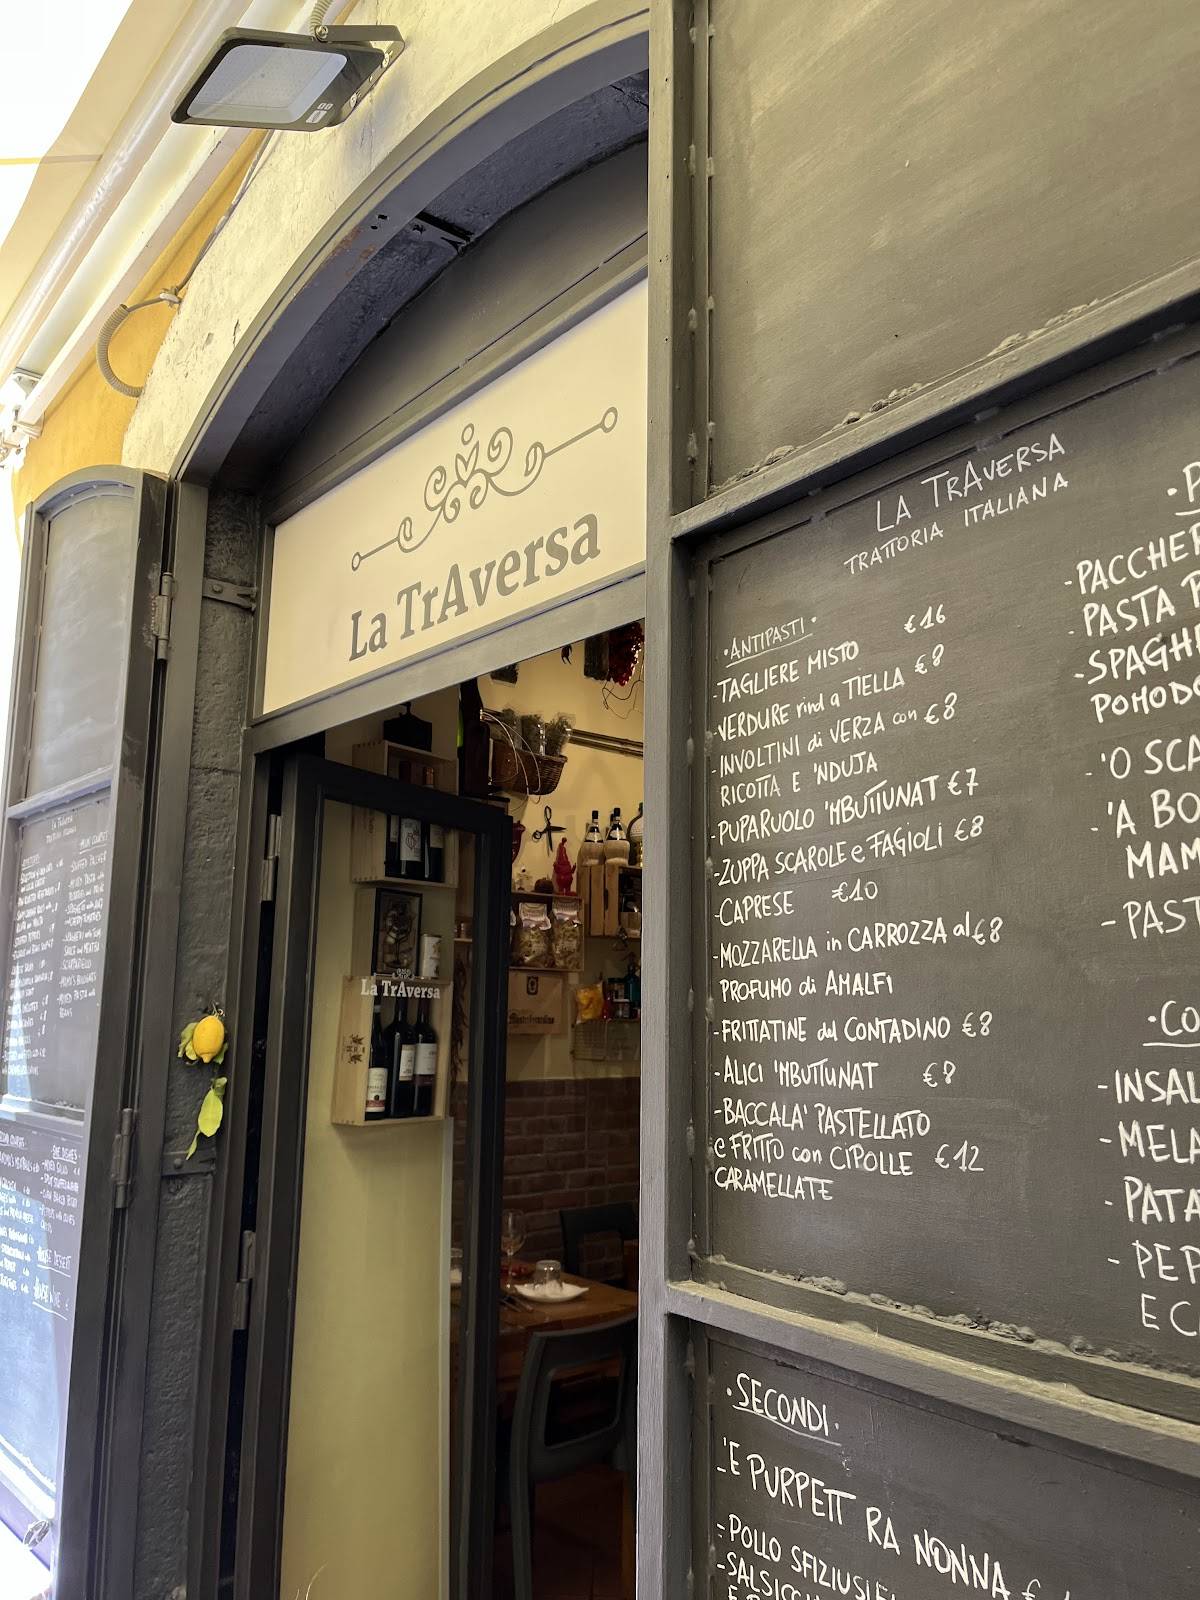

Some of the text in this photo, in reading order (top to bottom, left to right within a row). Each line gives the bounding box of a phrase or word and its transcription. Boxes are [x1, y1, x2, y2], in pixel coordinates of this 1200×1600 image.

[843, 466, 1069, 575] TRATTORIA ITALIANA
[876, 494, 912, 533] LA
[348, 512, 601, 662] La TrAversa
[807, 640, 860, 675] MISTO
[841, 666, 906, 700] TIELLA
[829, 711, 886, 744] VERZA
[720, 773, 781, 808] RICOTTA
[792, 770, 801, 793] E
[774, 840, 848, 875] SCAROLE
[826, 931, 843, 952] in
[847, 916, 948, 953] CARROZZA
[361, 978, 441, 999] La TrAversa
[718, 977, 792, 1003] PROFUMO
[824, 968, 894, 997] AMALFI
[843, 1015, 951, 1044] CONTADINO
[813, 1102, 931, 1140] PASTELLATO
[728, 1130, 785, 1164] FRITTO
[791, 1146, 823, 1165] con
[714, 1165, 835, 1201] CARAMELLATE
[1169, 1300, 1200, 1337] C
[746, 1453, 857, 1526] PURPETT
[865, 1506, 901, 1556] RA
